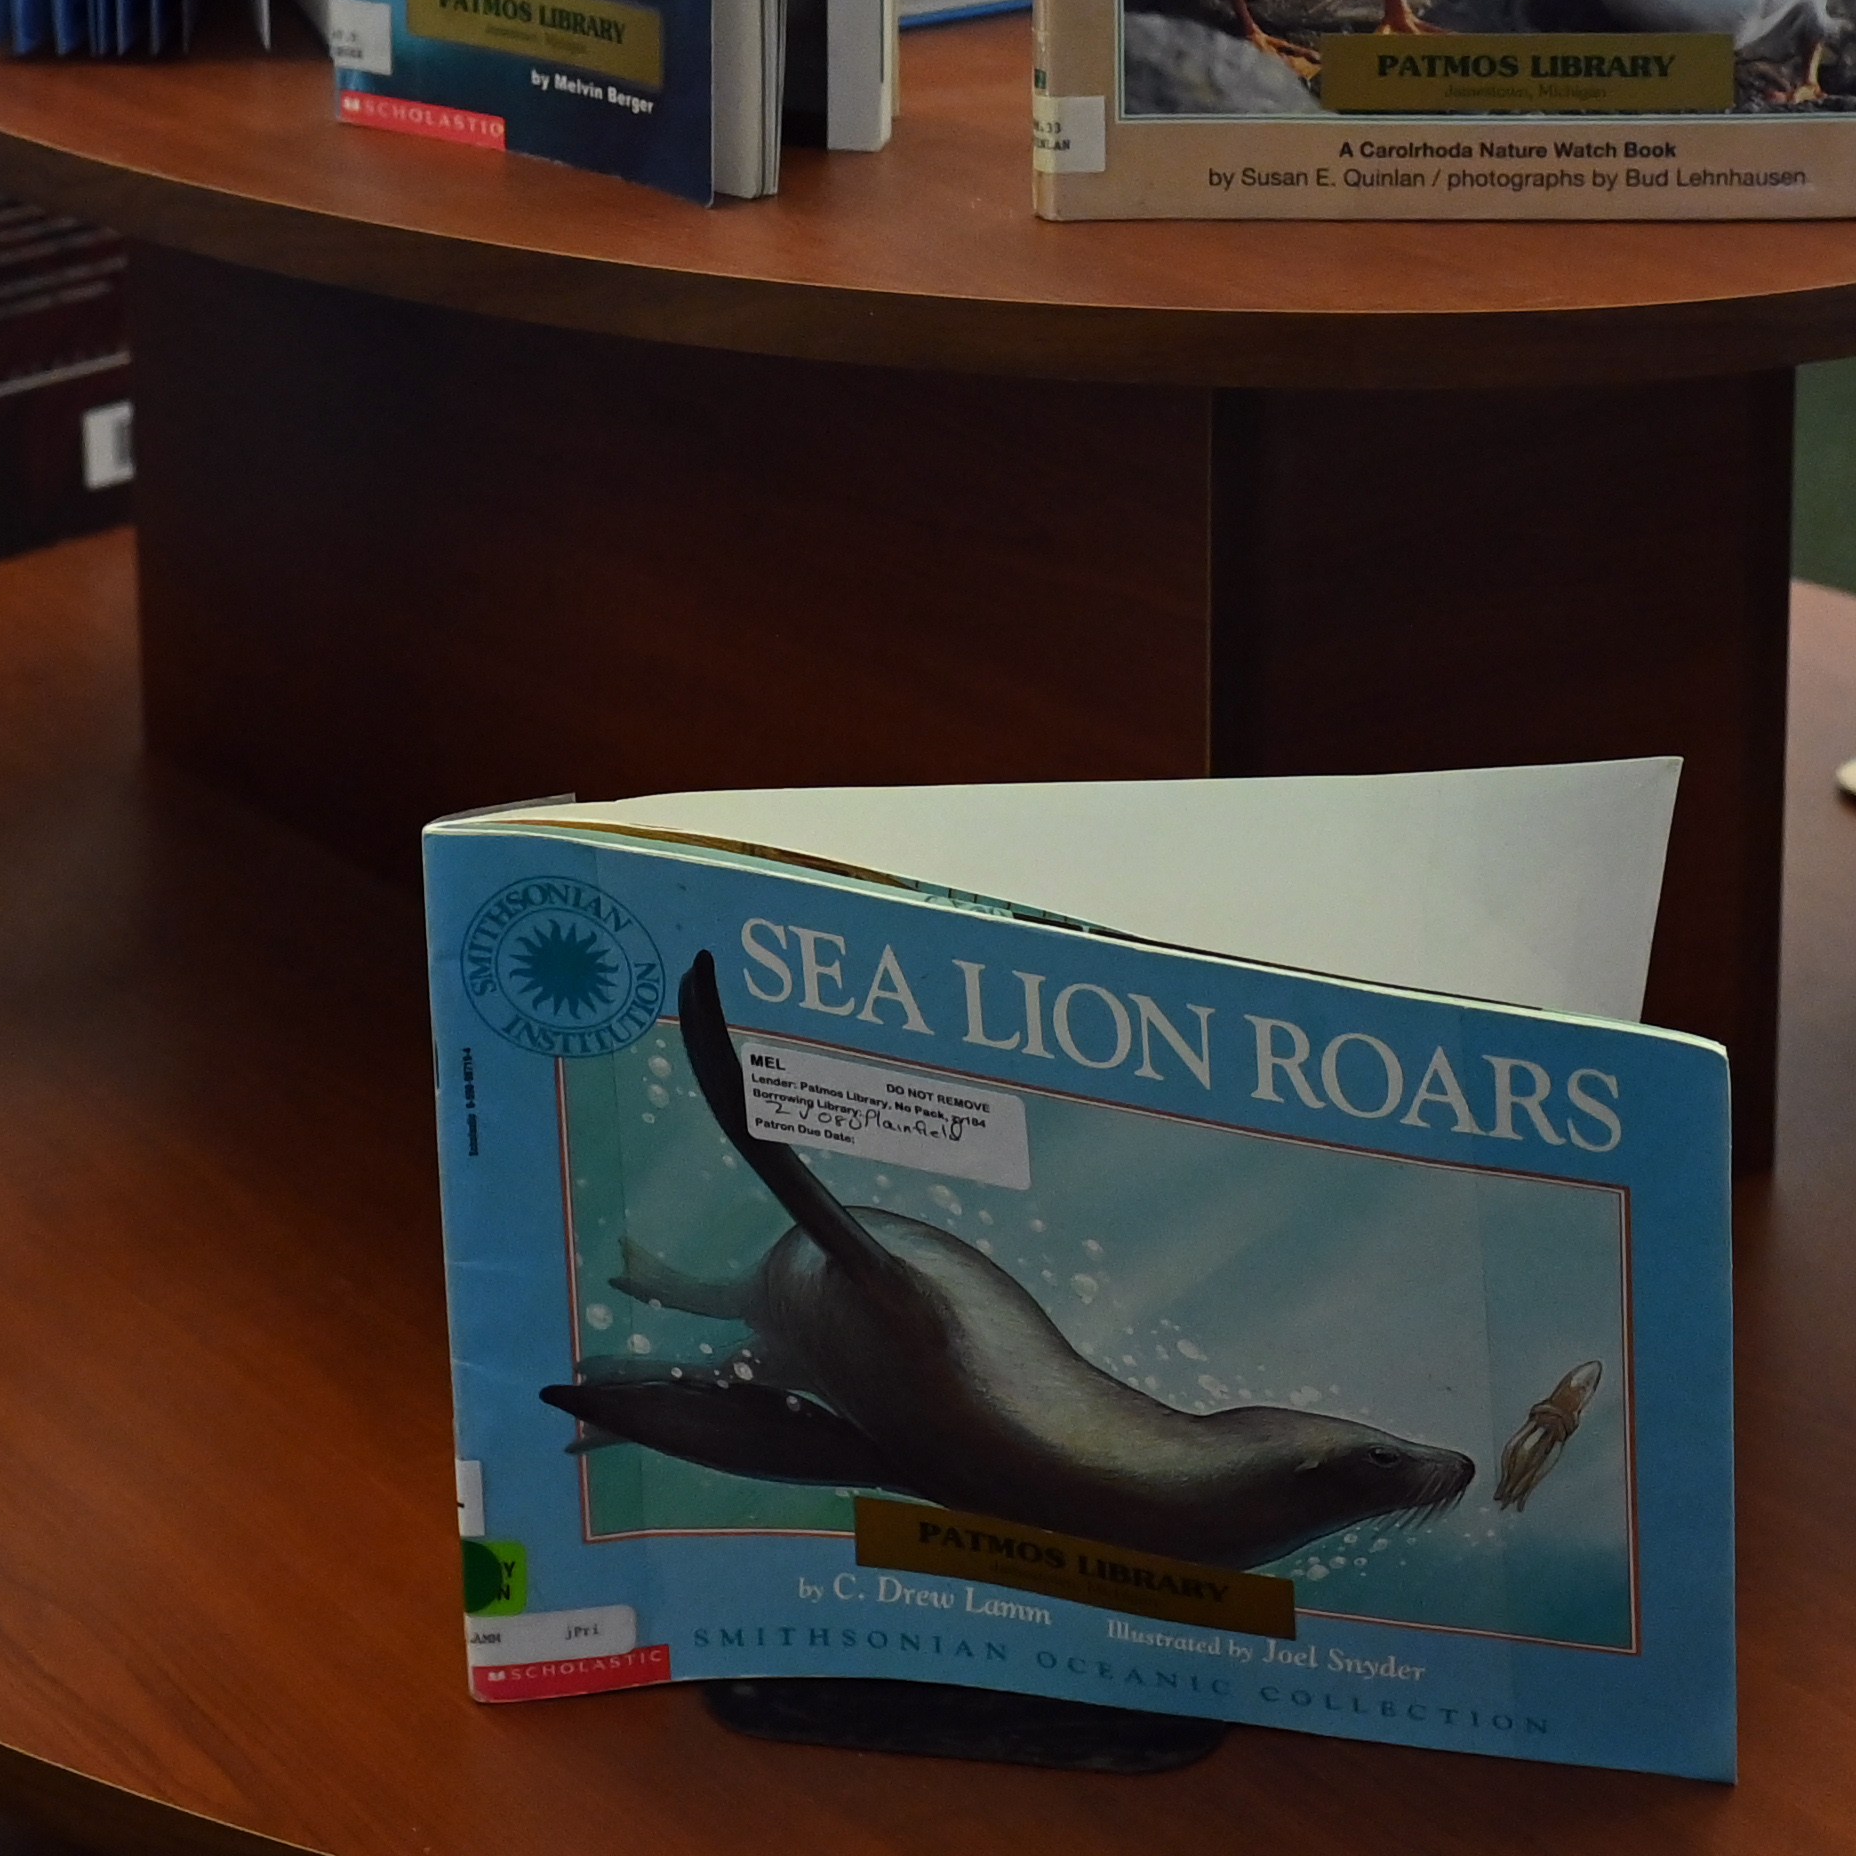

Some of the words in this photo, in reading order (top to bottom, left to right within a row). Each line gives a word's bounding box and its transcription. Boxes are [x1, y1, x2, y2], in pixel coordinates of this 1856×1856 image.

[539, 5, 627, 45] LIBRARY
[1377, 54, 1519, 78] PATMOS
[1530, 54, 1676, 78] LIBRARY
[531, 68, 550, 91] by
[554, 73, 604, 101] Melvin
[607, 86, 655, 115] Berger
[365, 96, 505, 140] SCHOLASTIC
[1339, 142, 1354, 159] A
[1359, 141, 1473, 159] Carolrhoda
[1479, 142, 1548, 159] Nature
[1553, 141, 1617, 159] Watch
[1623, 141, 1677, 159] Book
[1208, 167, 1235, 191] by
[1240, 167, 1308, 189] Susan
[1316, 168, 1336, 188] E.
[1343, 167, 1425, 190] Quinlan
[1430, 167, 1442, 189] /
[1447, 167, 1585, 192] photographs
[1592, 167, 1621, 192] by
[1625, 167, 1669, 189] Bud
[1676, 167, 1807, 189] Lehnhausen
[467, 882, 634, 997] SMITHSONIAN
[501, 962, 660, 1054] INSTITUTION
[740, 917, 934, 1036] SEA
[952, 956, 1216, 1088] LION
[1243, 1012, 1622, 1153] ROARS
[750, 1053, 786, 1071] MEL
[751, 1072, 797, 1090] Lender:
[800, 1081, 844, 1098] Patmos
[895, 1101, 912, 1113] No
[752, 1087, 814, 1110] Borrowing
[886, 1083, 905, 1096] DO
[907, 1087, 934, 1103] NOT
[936, 1094, 991, 1114] REMOVE
[755, 1116, 795, 1134] Patron
[798, 1123, 821, 1137] Due
[864, 1108, 963, 1142] Plainfield
[917, 1520, 1066, 1569] PATMOS
[1078, 1555, 1229, 1603] LIBRARY
[798, 1576, 824, 1604] by
[833, 1572, 865, 1601] C.
[878, 1575, 956, 1611] Drew
[965, 1586, 1053, 1626] Lamm
[511, 1650, 662, 1681] SCHOLASTIC
[1106, 1618, 1221, 1656] Illustrated
[1229, 1640, 1254, 1664] by
[1262, 1638, 1318, 1670] Joel
[1328, 1647, 1427, 1682] Snyder
[693, 1626, 1008, 1663] SMITHSONIAN
[1037, 1650, 1232, 1696] OCEANIC
[1260, 1685, 1549, 1735] COLLECTION
